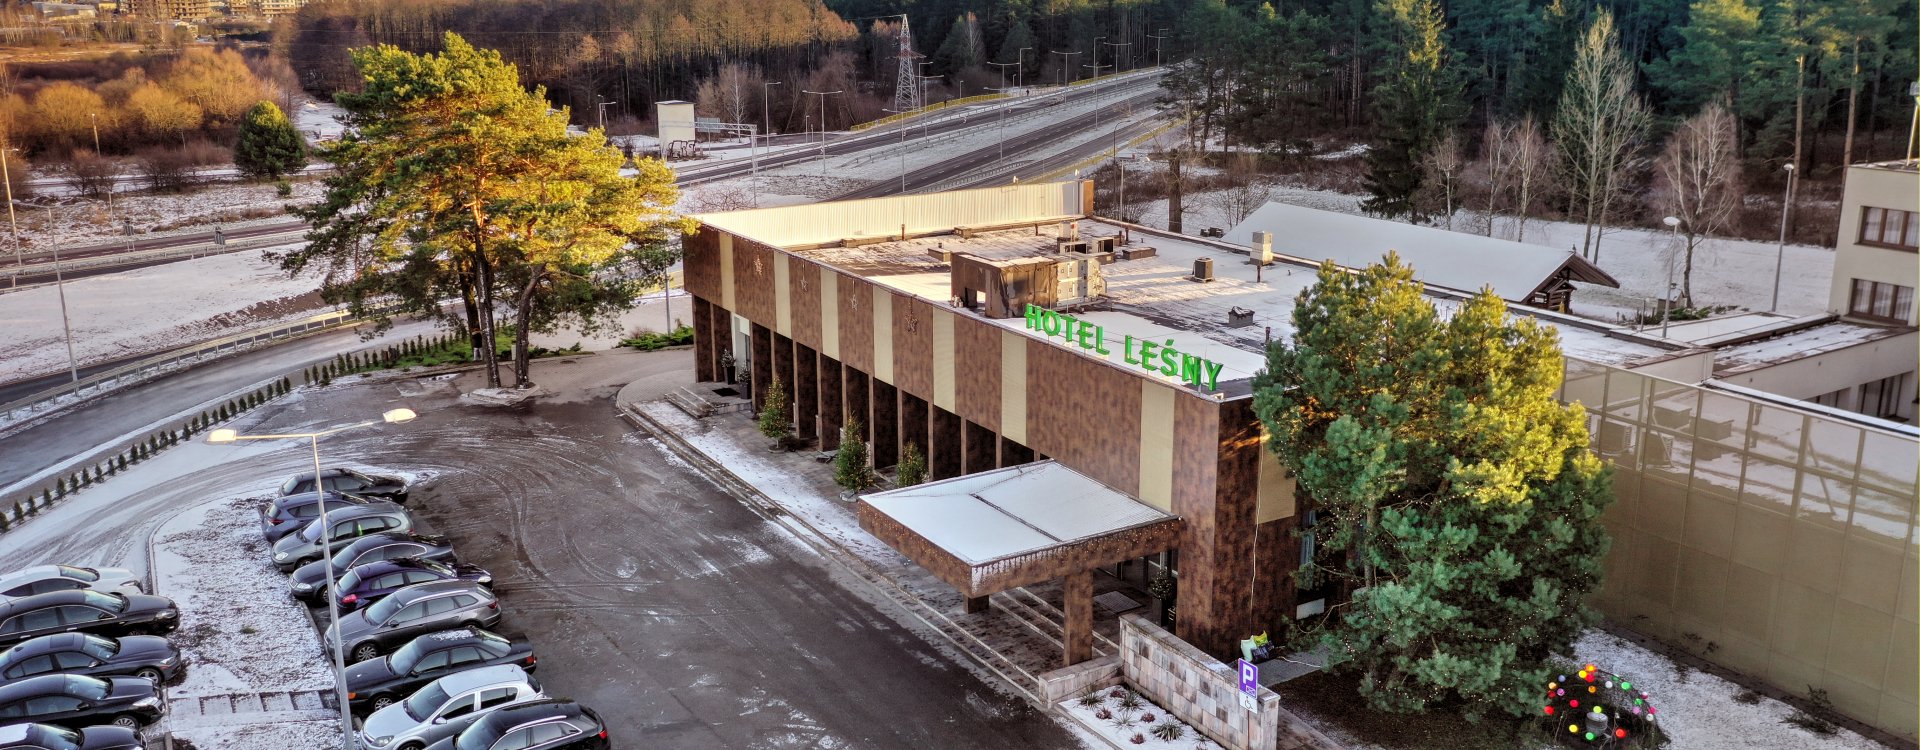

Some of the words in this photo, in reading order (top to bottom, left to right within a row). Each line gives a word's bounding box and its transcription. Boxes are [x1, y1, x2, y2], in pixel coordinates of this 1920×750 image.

[1024, 303, 1110, 355] HOTEL
[1124, 334, 1223, 391] LEŚNY
[1242, 663, 1254, 685] P
